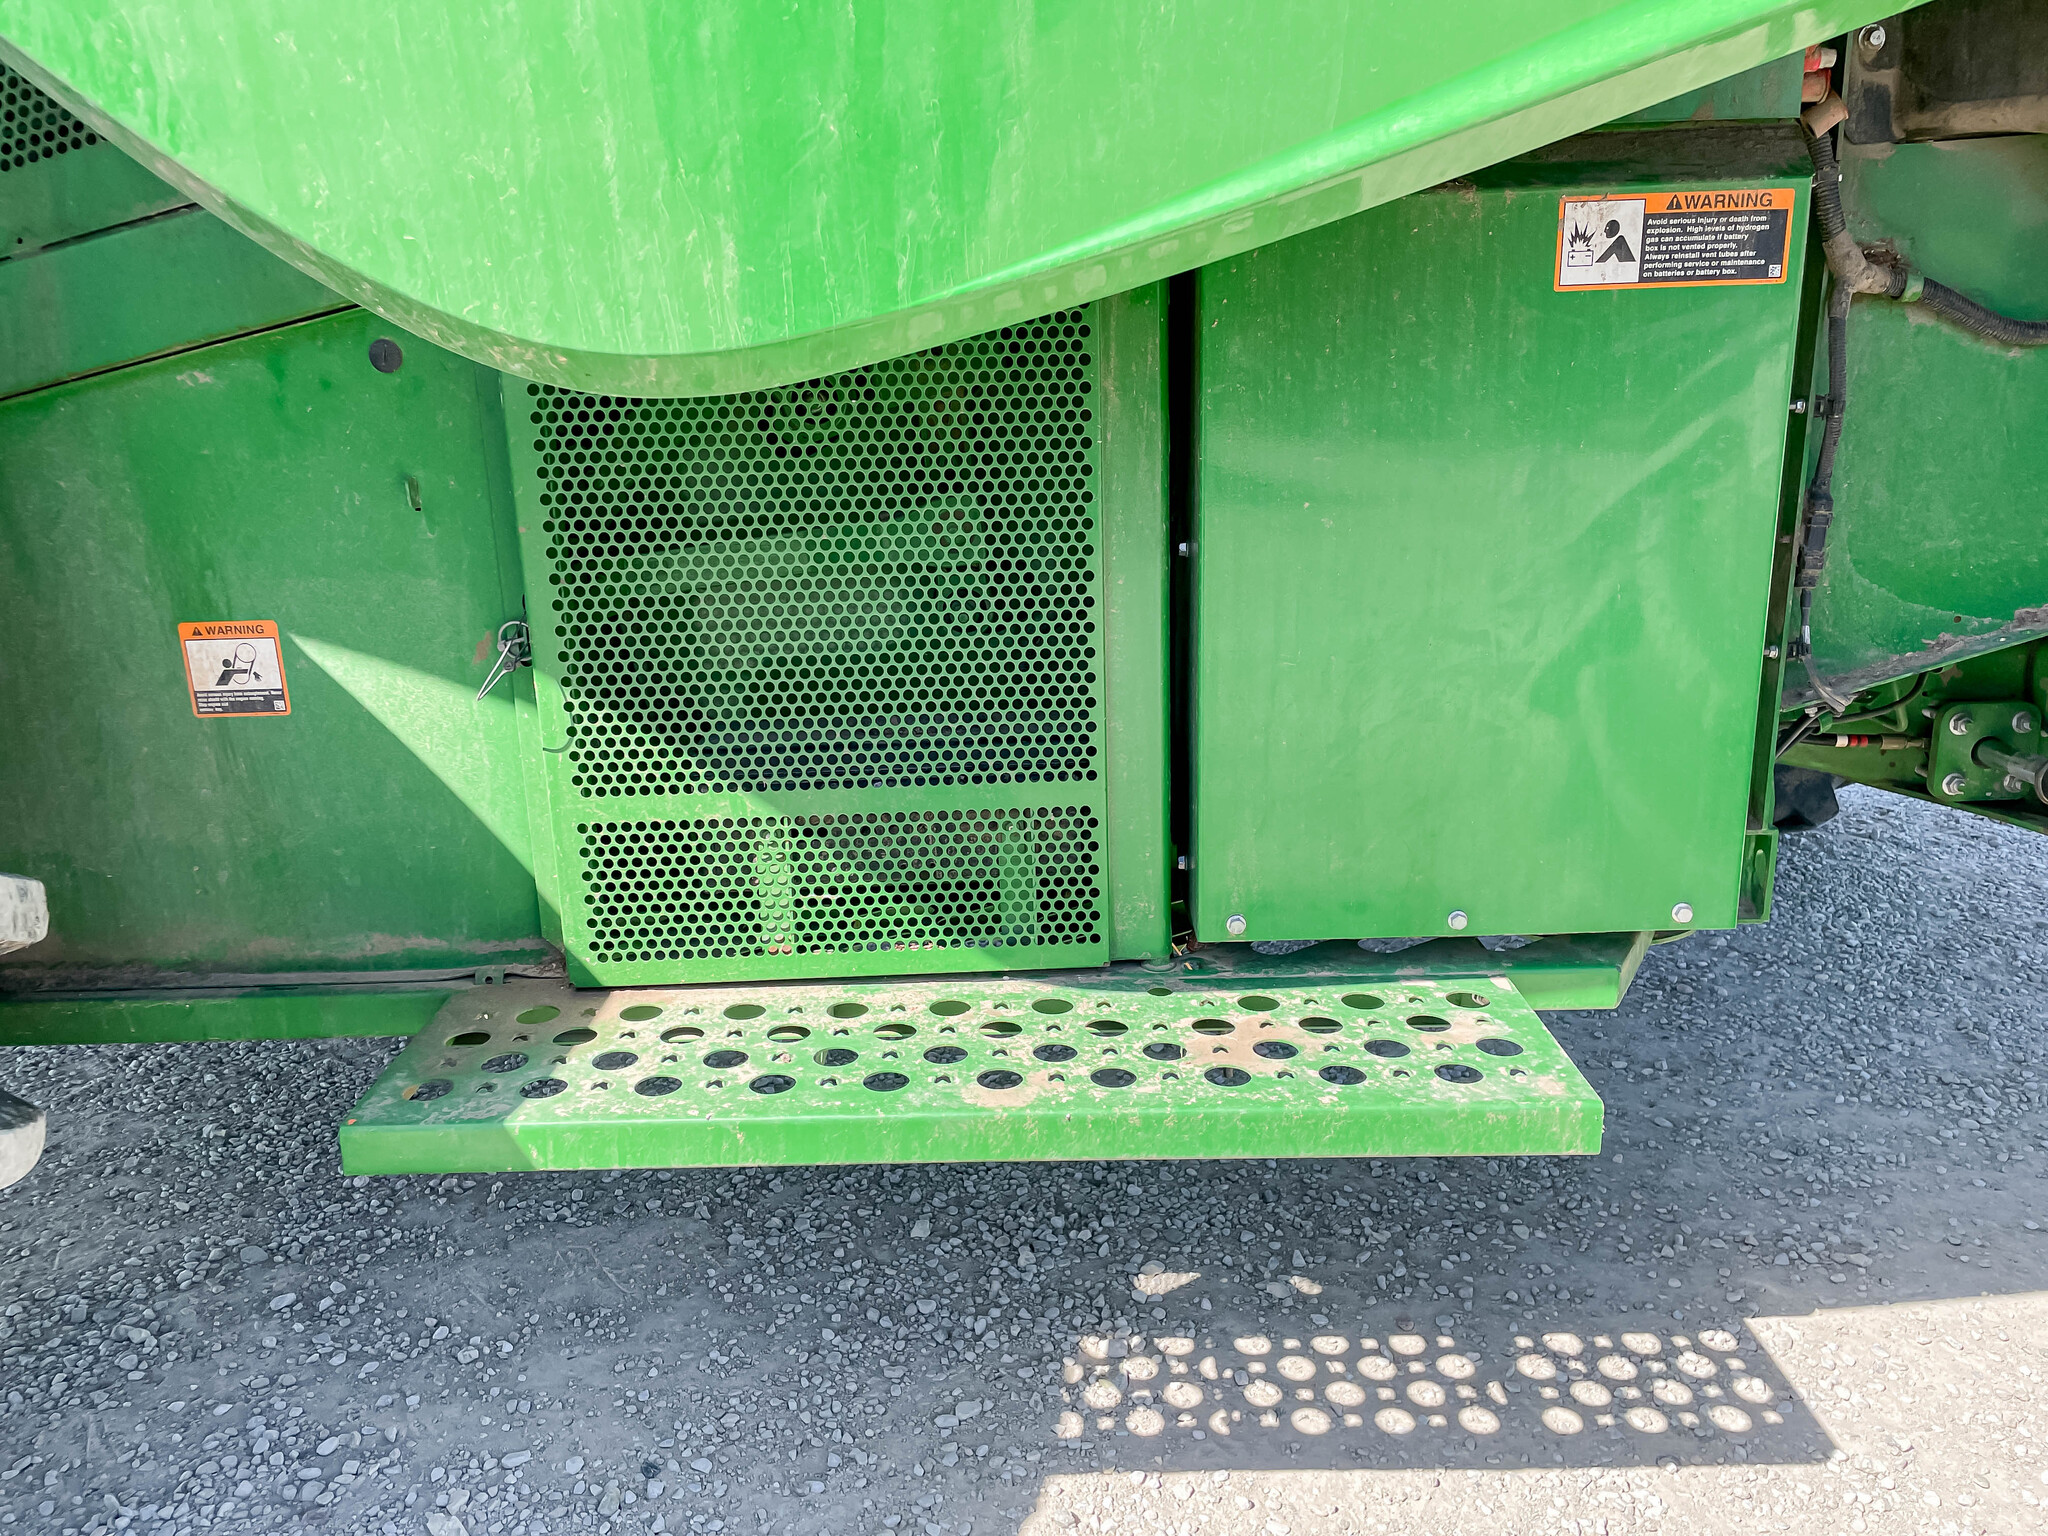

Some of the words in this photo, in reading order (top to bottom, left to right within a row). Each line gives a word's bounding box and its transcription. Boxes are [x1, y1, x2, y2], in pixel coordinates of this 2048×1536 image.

[1684, 192, 1772, 209] WARNING
[1647, 227, 1683, 235] explosion.
[1737, 224, 1769, 232] hydrogen
[1707, 242, 1738, 250] properly.
[1645, 253, 1669, 261] Always
[1644, 262, 1682, 270] performing
[204, 624, 264, 635] WARNING
